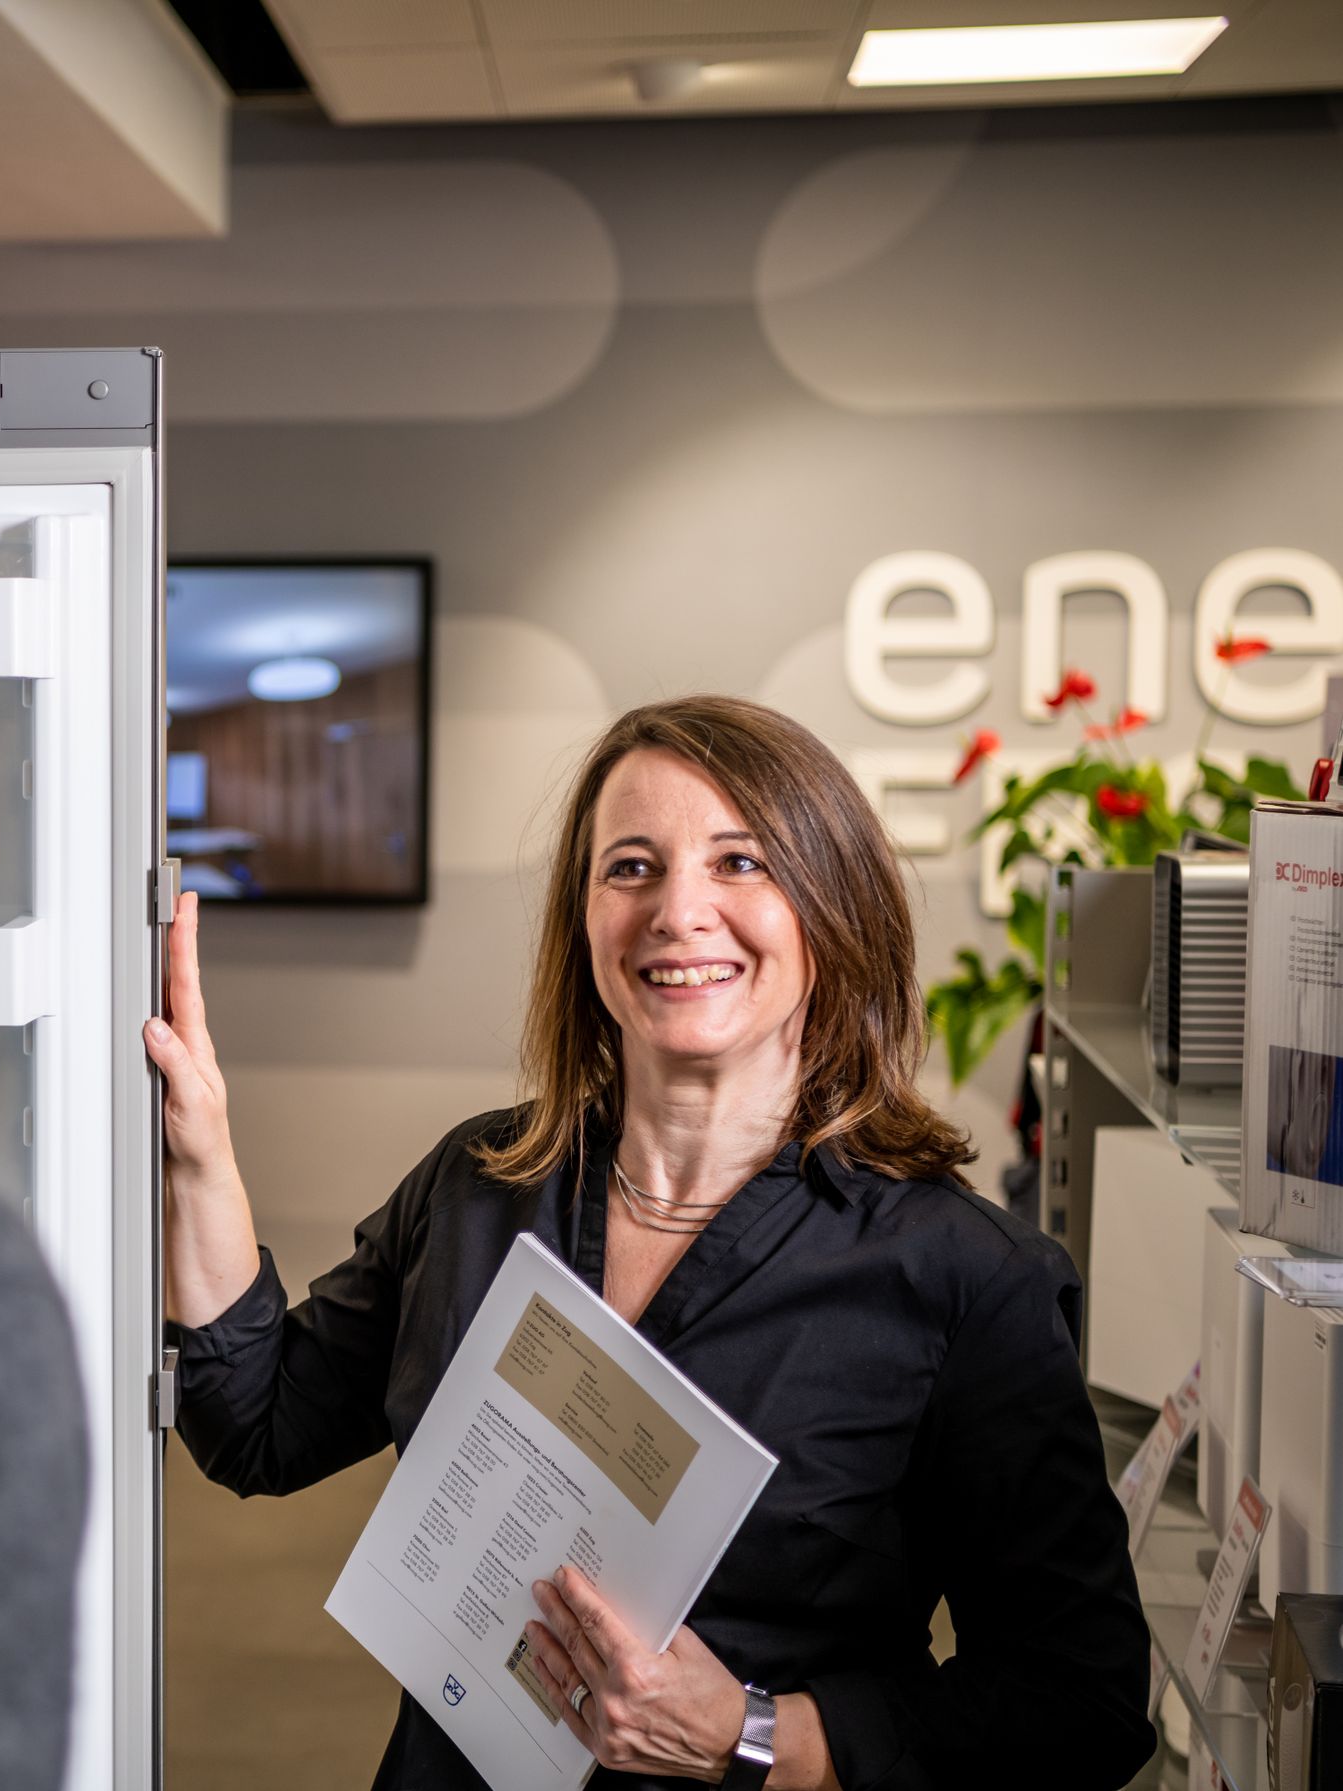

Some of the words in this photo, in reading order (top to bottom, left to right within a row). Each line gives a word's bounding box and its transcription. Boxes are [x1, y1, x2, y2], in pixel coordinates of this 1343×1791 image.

[483, 1399, 513, 1429] ZUGORAMA
[511, 1426, 541, 1457] Ausstellungs-
[540, 1452, 551, 1465] und
[549, 1461, 586, 1499] Beratungscenter
[445, 1683, 460, 1700] ZUG
